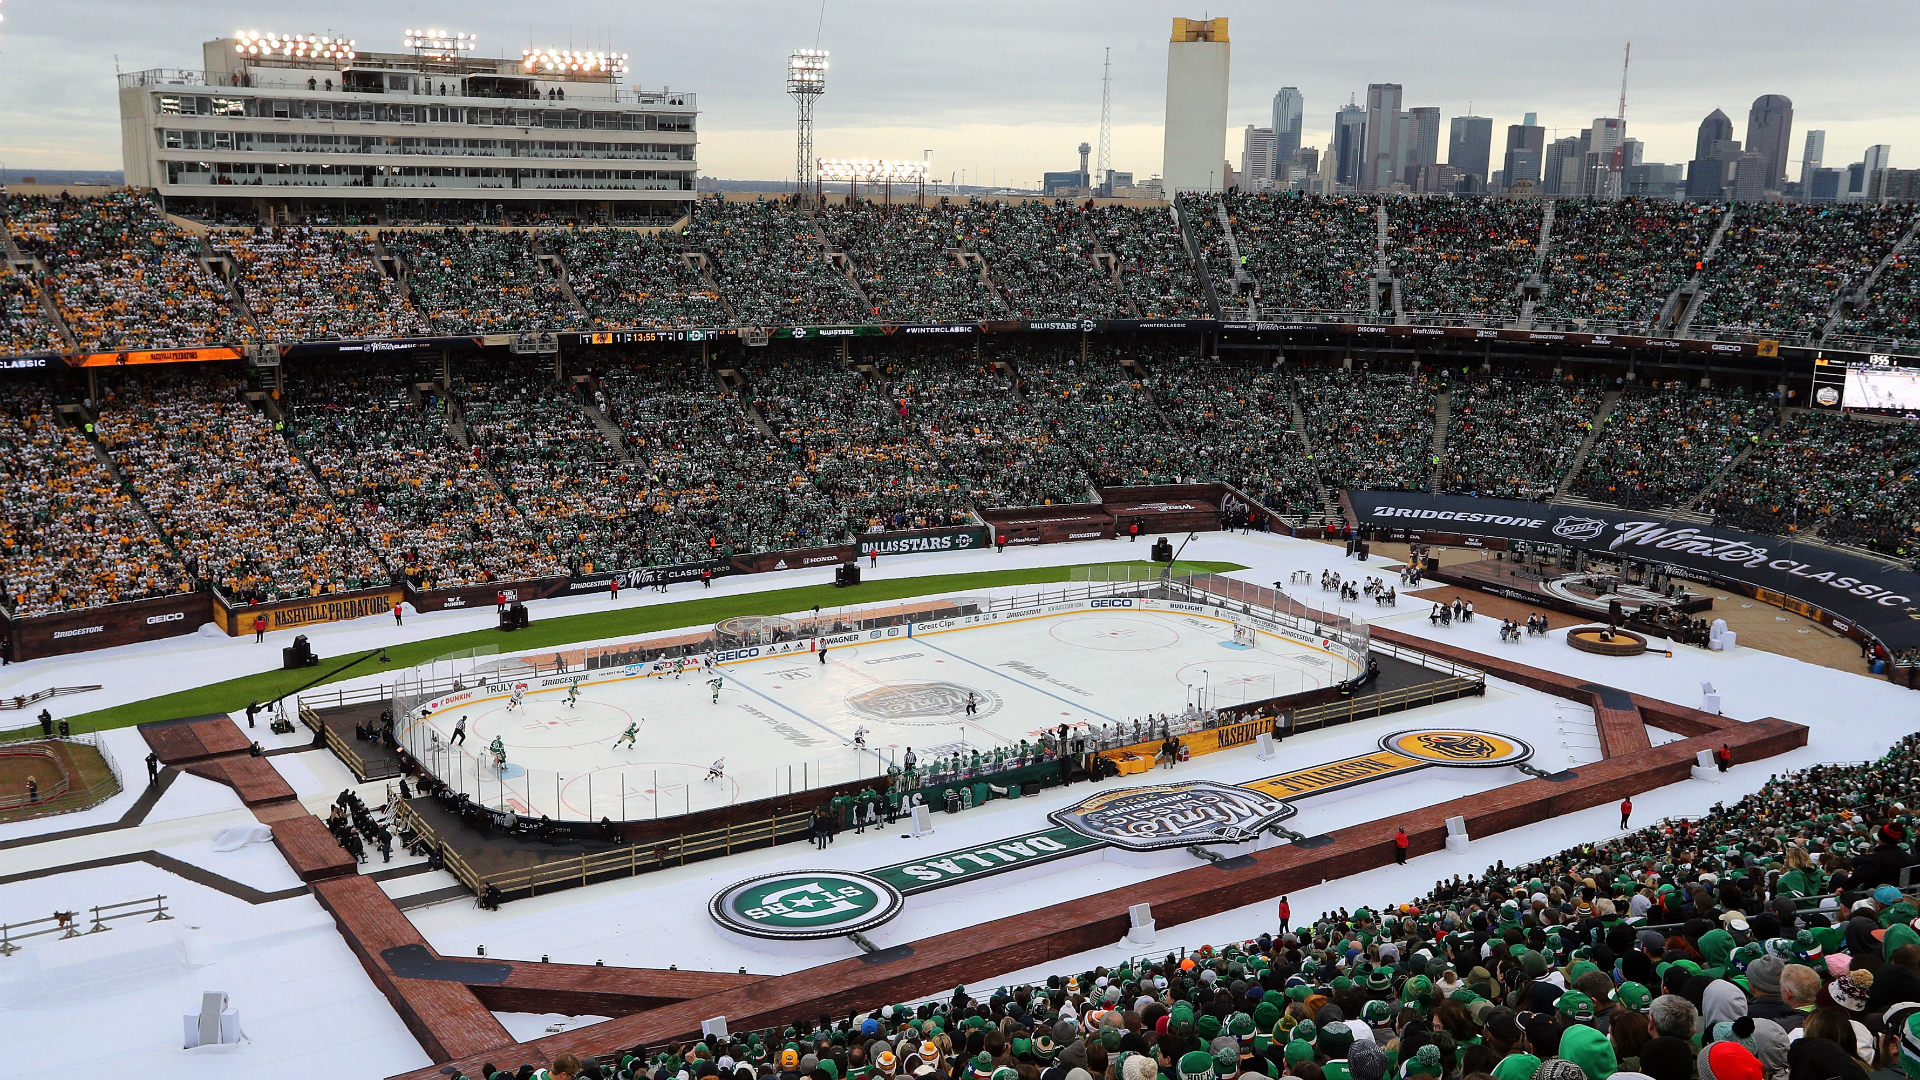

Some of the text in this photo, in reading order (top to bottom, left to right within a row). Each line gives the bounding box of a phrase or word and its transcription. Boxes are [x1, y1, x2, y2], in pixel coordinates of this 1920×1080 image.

[906, 326, 972, 334] #WINTERCLASSIC
[1050, 322, 1077, 331] STARS
[616, 333, 621, 343] 1
[633, 332, 656, 342] 13:55
[678, 332, 684, 341] 0
[1664, 340, 1682, 348] Clips
[1712, 344, 1742, 352] GEICO
[1869, 355, 1890, 365] 13:55
[862, 535, 953, 554] DALLAS STARS
[810, 555, 838, 563] HONDA
[1373, 506, 1911, 607] BRIDGESTONE NHL Winter CLASSIC
[1664, 564, 1690, 579] Winter
[570, 580, 612, 590] BRIDGESTONE
[1090, 599, 1133, 608] GEICO
[1184, 604, 1204, 612] LIGHT
[274, 595, 390, 626] NASHVILLE PREDATORS
[1006, 608, 1042, 619] BRIDGESTONE
[146, 611, 185, 625] GEICO
[53, 624, 104, 639] BRIDGESTONE
[917, 622, 939, 631] Great
[938, 620, 956, 629] Clips
[827, 635, 859, 645] WAGNER
[1281, 628, 1315, 643] BRIDGESTONE
[716, 648, 759, 662] GEICO
[625, 666, 641, 675] SAP
[541, 674, 591, 687] BRIDGESTONE
[485, 682, 514, 695] TRULY
[445, 692, 473, 705] DUNKIN'
[1218, 719, 1272, 749] NASHVILLE
[1267, 758, 1394, 793] NASHVILLE
[1105, 792, 1193, 817] BRIDGESTONE
[1114, 793, 1159, 806] 2020
[1101, 792, 1285, 838] Winter
[1105, 794, 1222, 826] CLASSIC
[902, 836, 1067, 882] DALLAS
